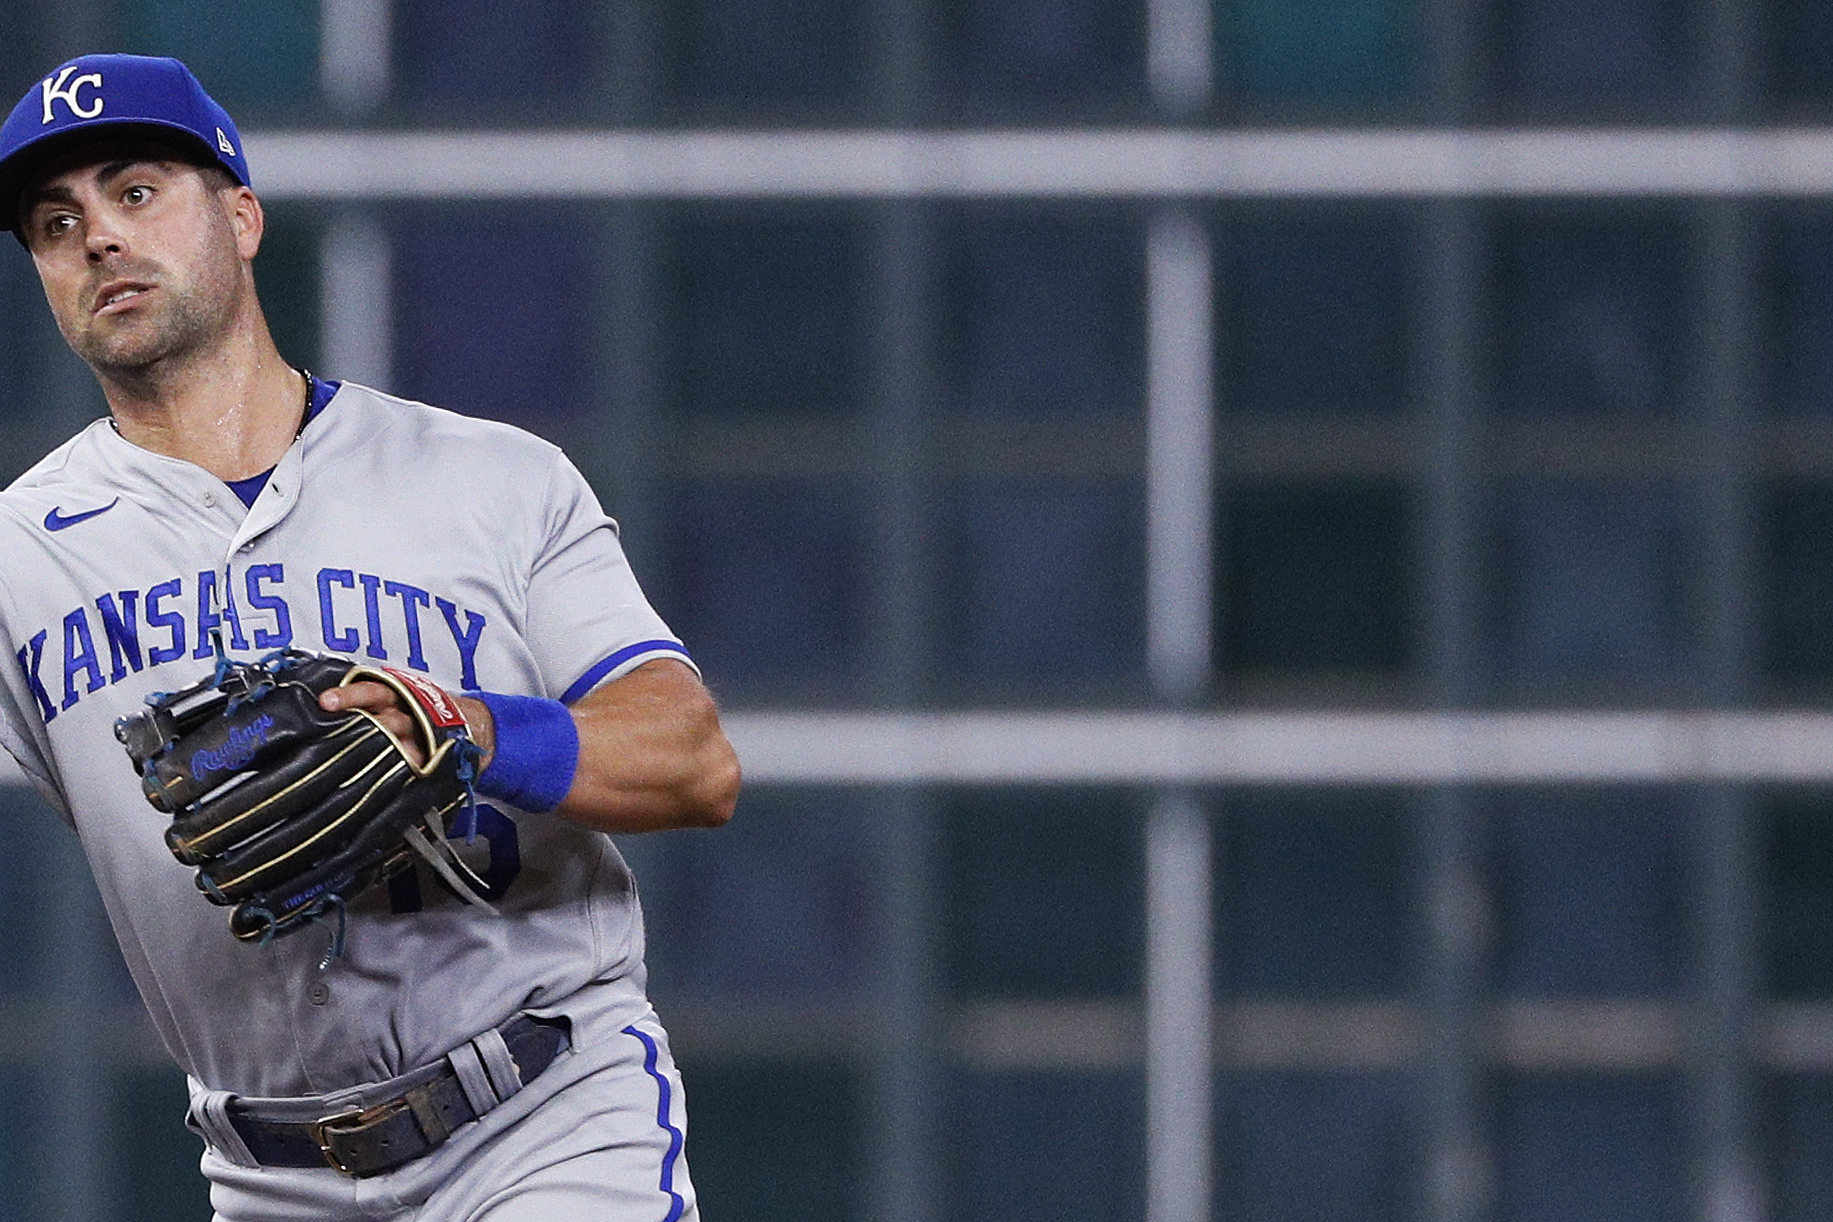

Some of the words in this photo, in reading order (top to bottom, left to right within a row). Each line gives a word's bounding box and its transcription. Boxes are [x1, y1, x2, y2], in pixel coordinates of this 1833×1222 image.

[42, 65, 104, 124] KC
[17, 564, 293, 724] KANSAS
[316, 567, 486, 693] CITY
